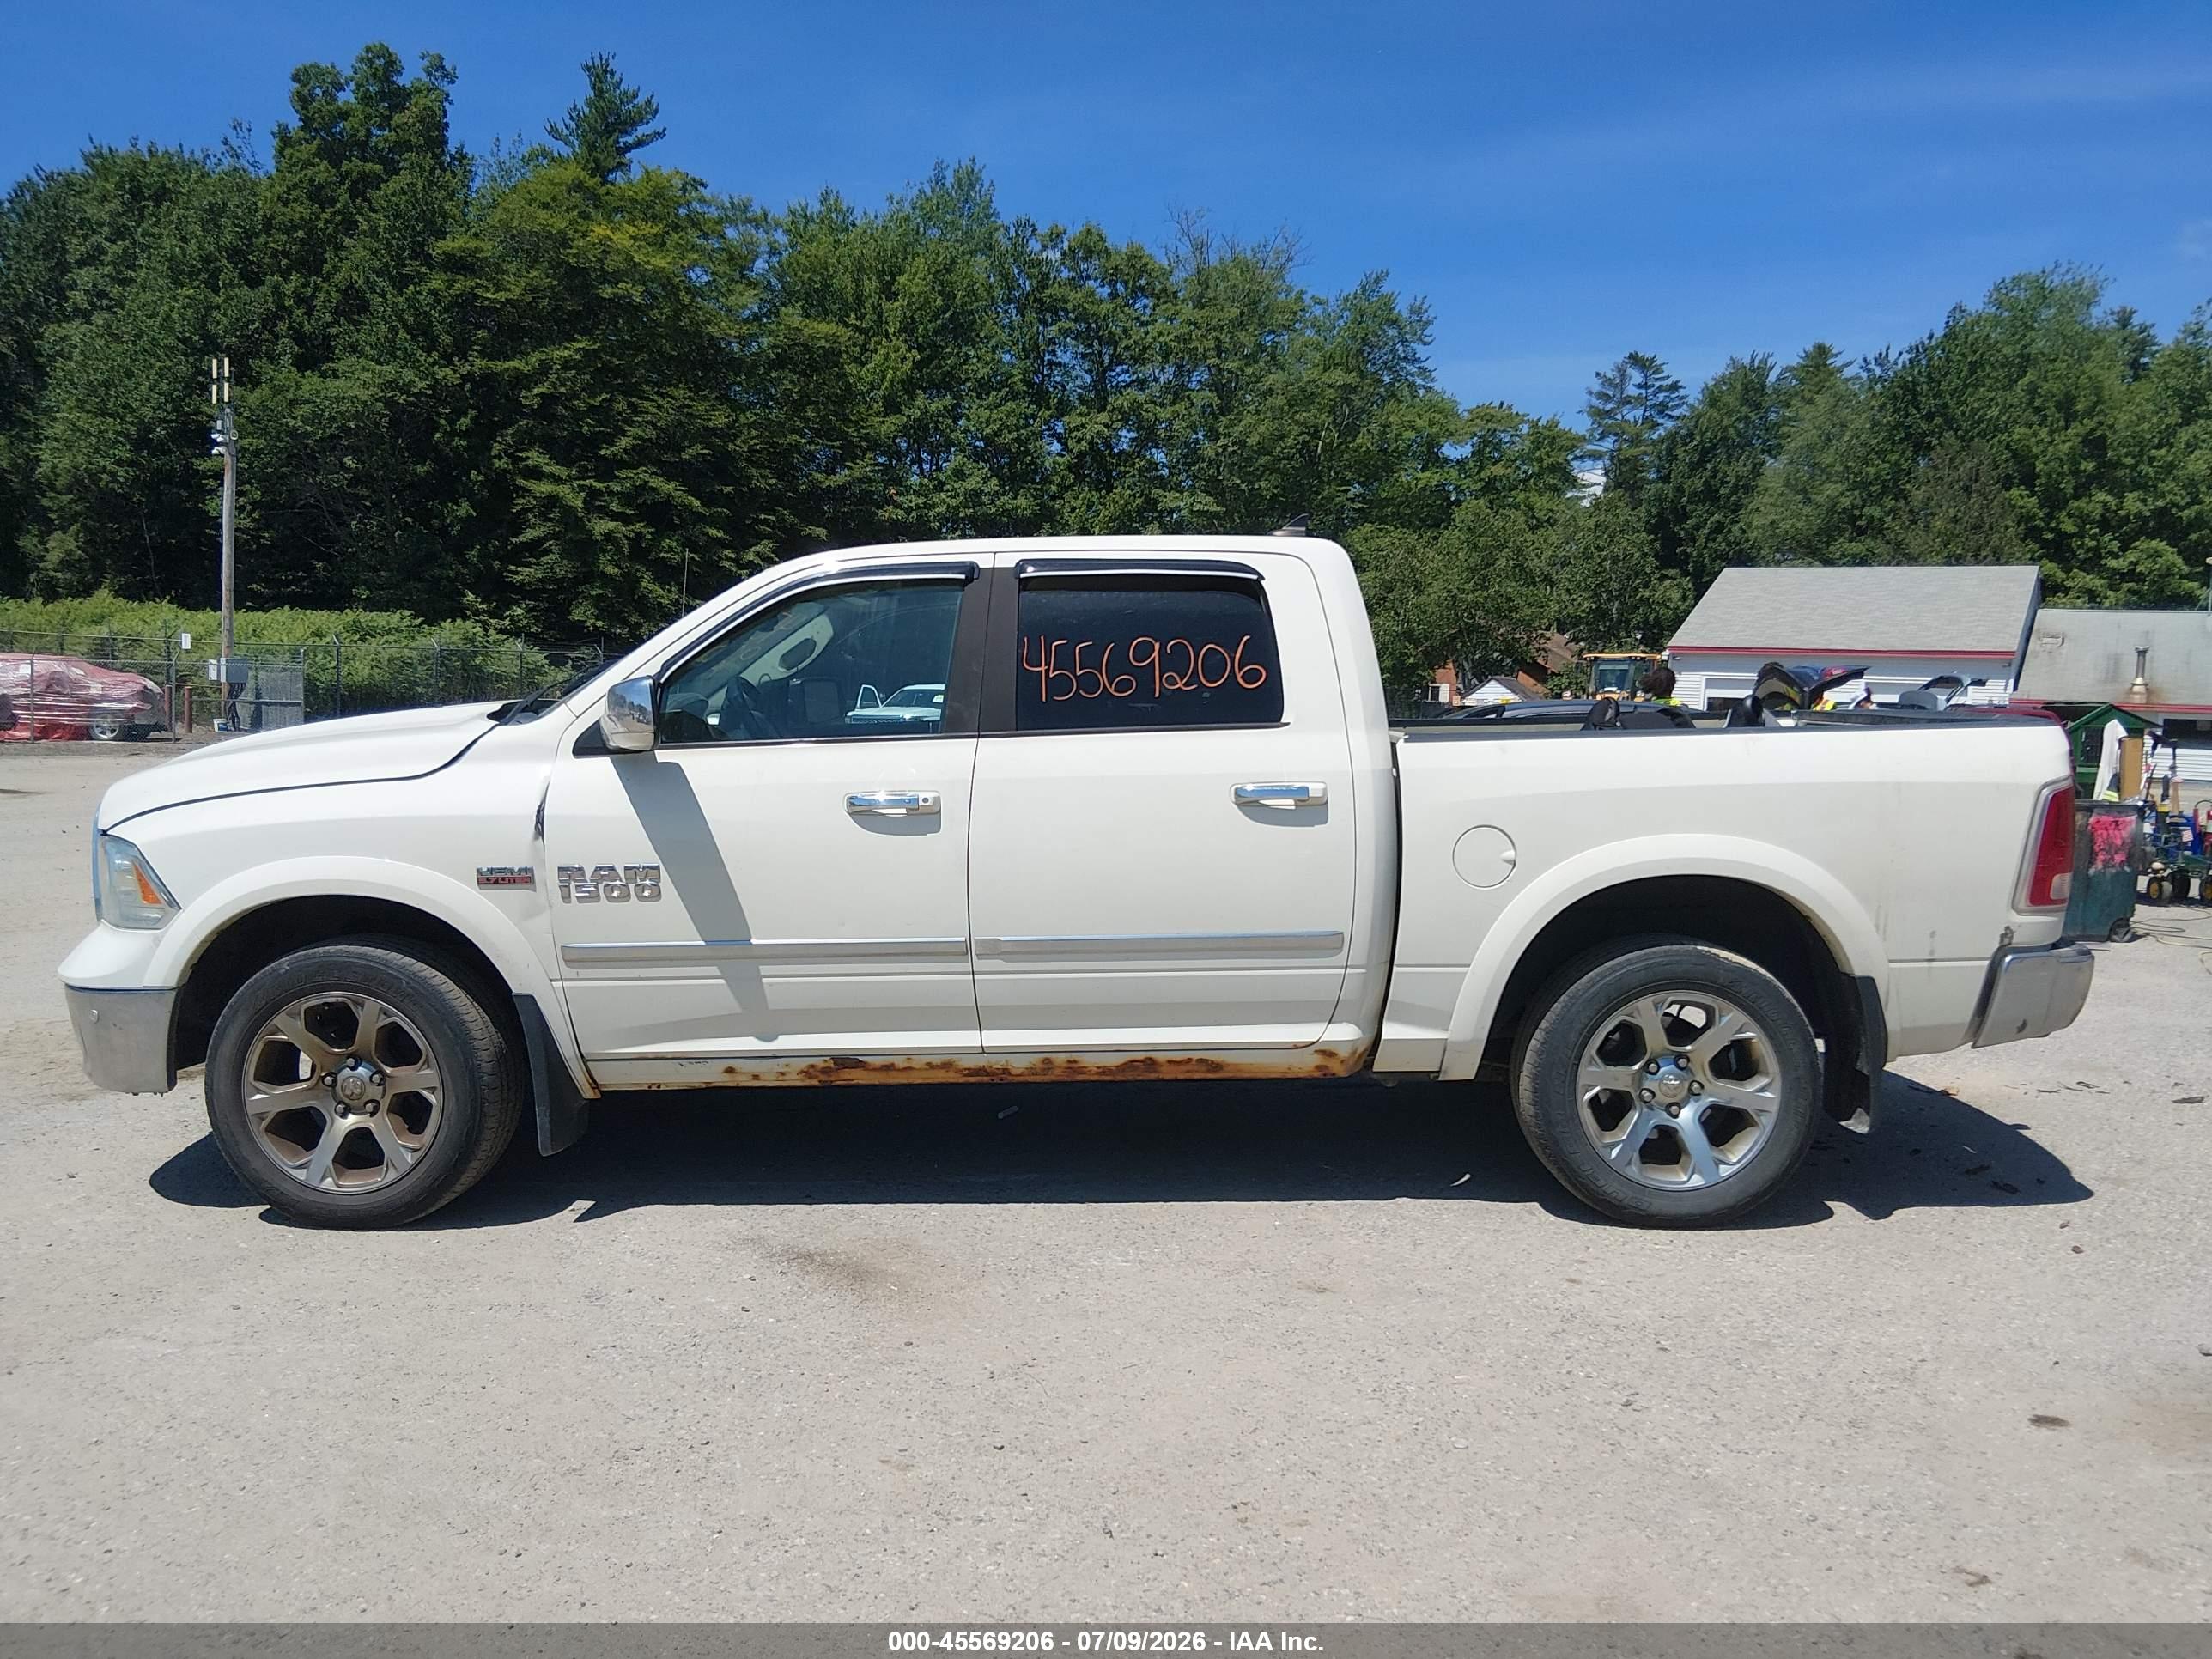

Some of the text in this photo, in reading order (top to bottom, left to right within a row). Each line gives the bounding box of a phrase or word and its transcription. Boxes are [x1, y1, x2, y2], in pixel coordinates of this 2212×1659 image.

[1022, 635, 1267, 702] 45569206
[477, 866, 532, 876] HEMI
[557, 864, 661, 884] RAM
[558, 881, 662, 903] 1500
